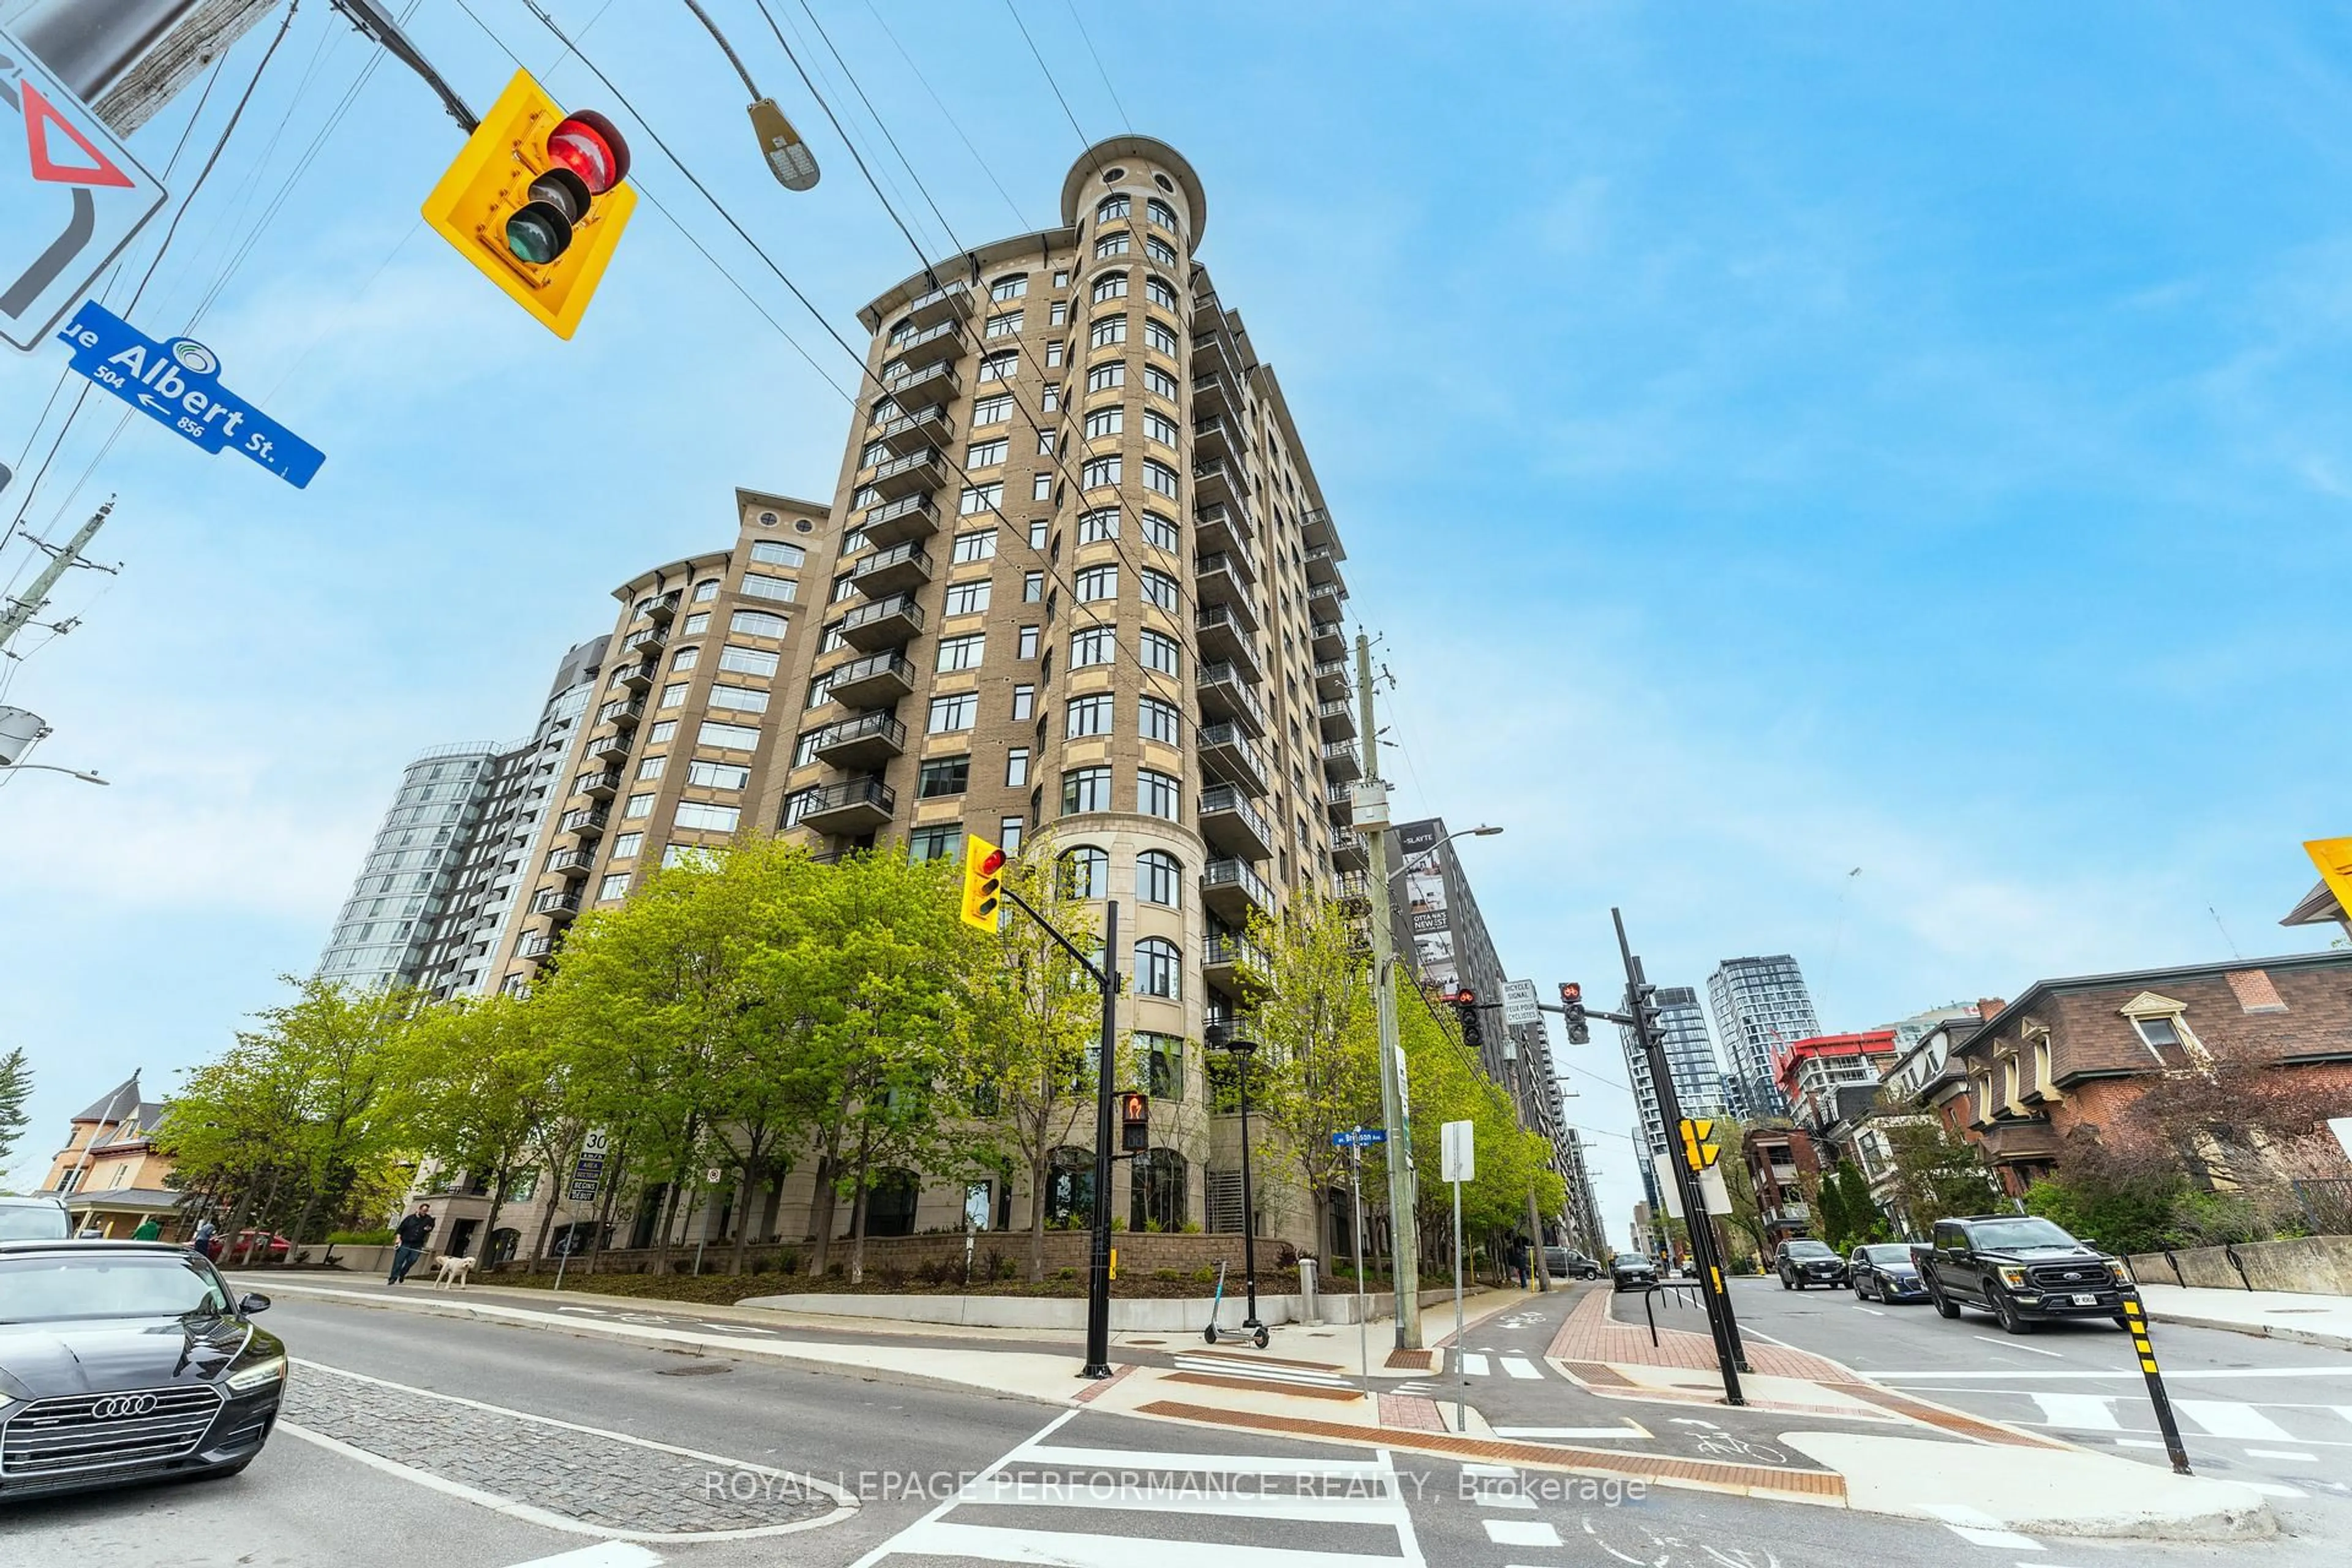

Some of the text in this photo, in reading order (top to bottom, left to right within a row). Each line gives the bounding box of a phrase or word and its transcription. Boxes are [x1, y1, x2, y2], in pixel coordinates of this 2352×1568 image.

[62, 323, 274, 462] ue Albert St.
[93, 365, 205, 437] 504 856
[1505, 983, 1529, 992] BICYCLE
[587, 1134, 607, 1149] 30
[1345, 1134, 1372, 1142] Brson
